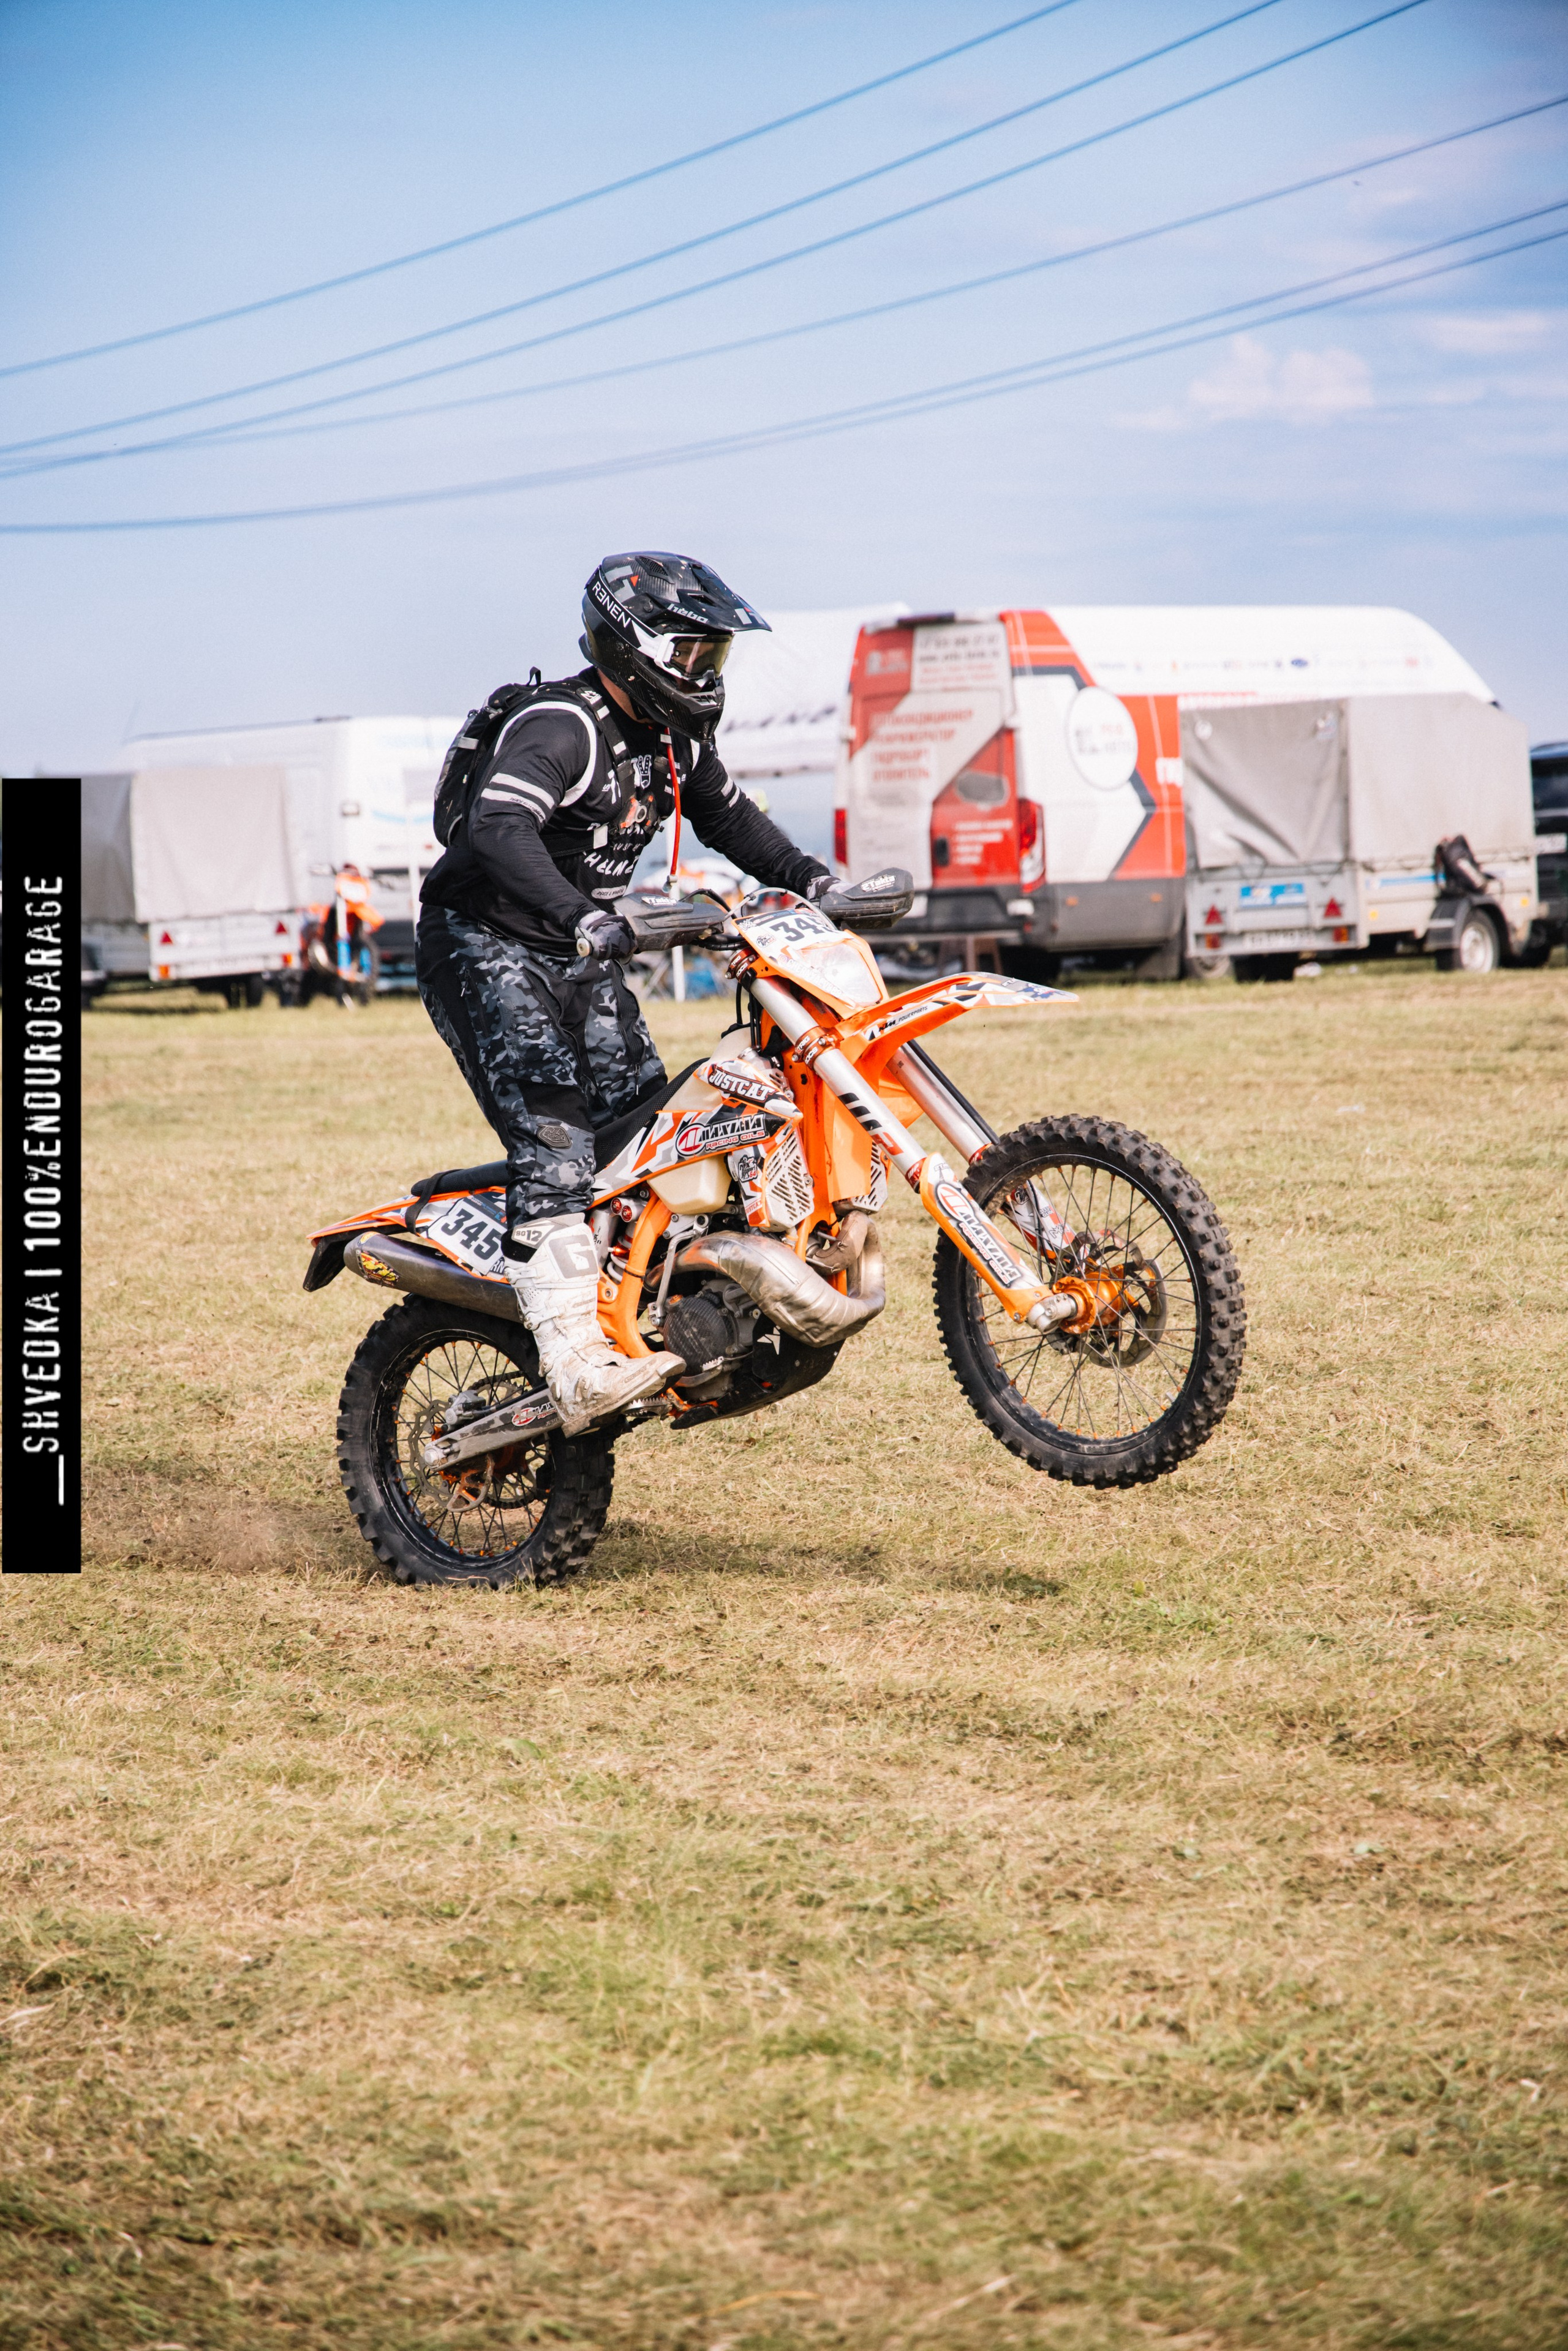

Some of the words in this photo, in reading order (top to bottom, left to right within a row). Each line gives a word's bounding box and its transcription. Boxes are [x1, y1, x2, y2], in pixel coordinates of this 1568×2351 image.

[710, 1068, 774, 1101] JUSTCAT
[706, 1136, 739, 1150] RACING
[740, 1130, 765, 1143] OILS
[440, 1208, 503, 1261] 345
